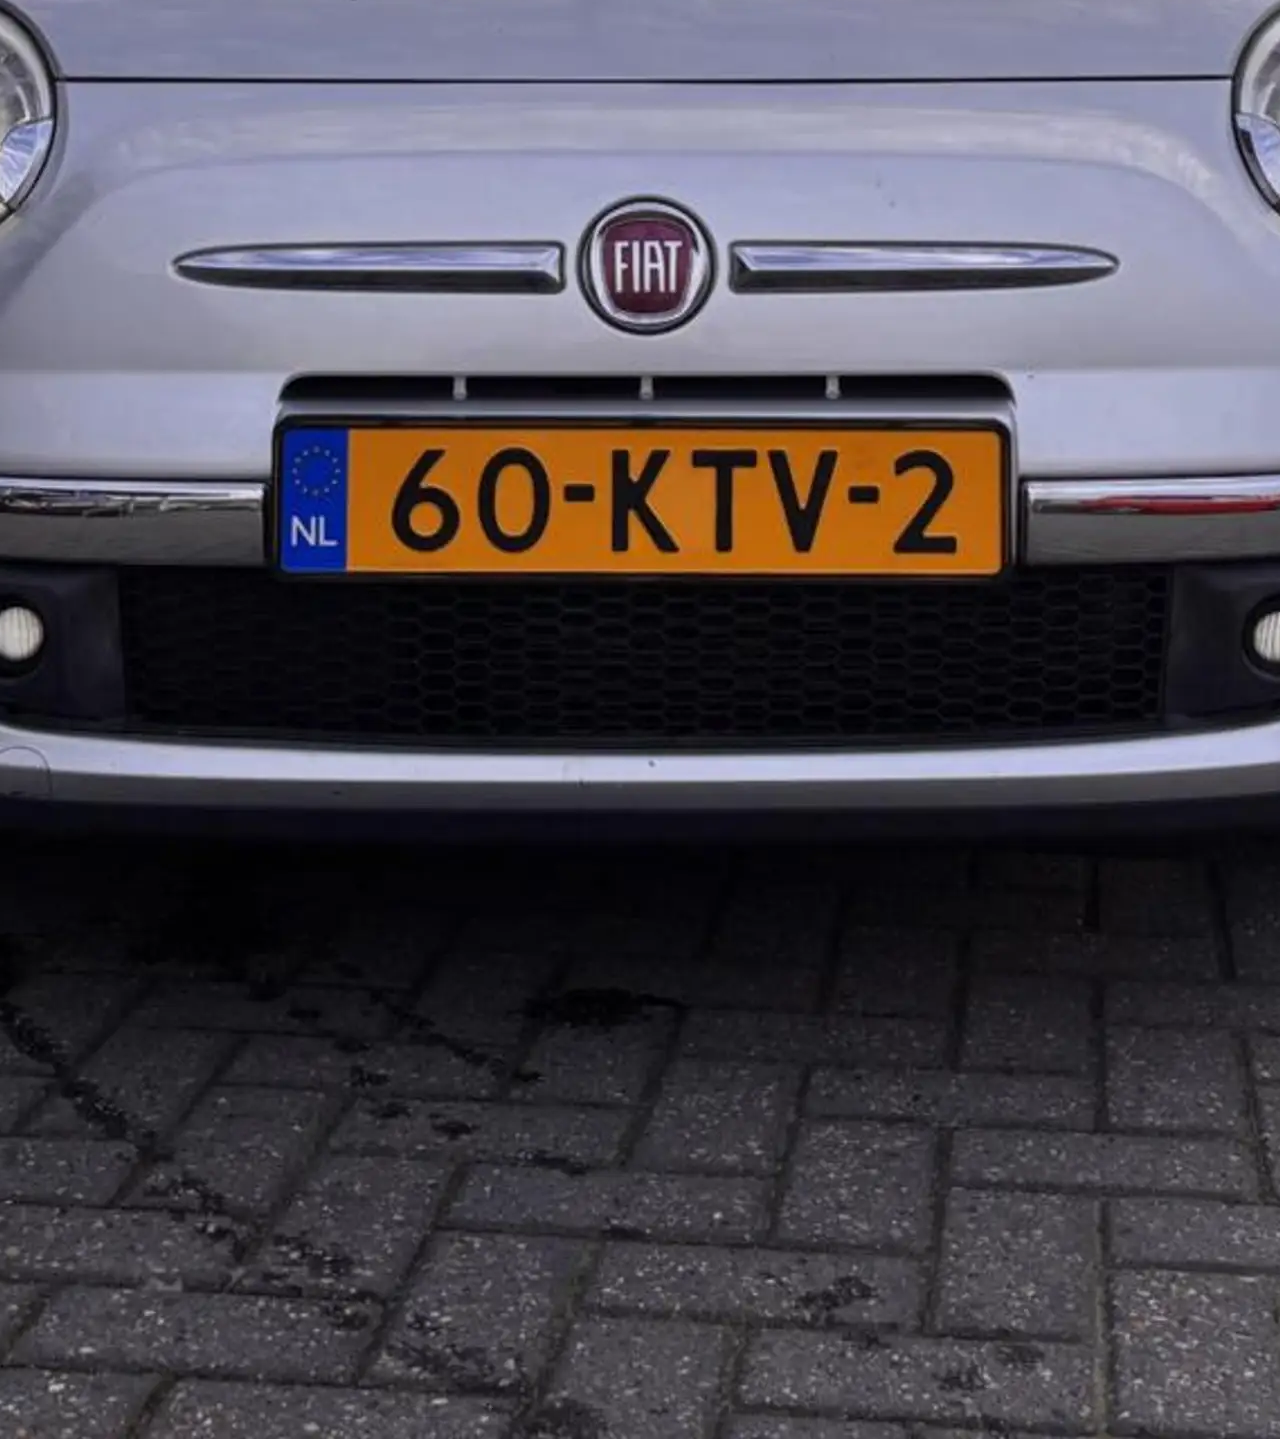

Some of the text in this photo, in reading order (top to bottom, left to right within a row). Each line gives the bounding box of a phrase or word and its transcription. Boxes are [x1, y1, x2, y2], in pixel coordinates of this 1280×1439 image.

[614, 240, 683, 293] FIAT
[391, 448, 958, 554] 60-KTV-2
[291, 515, 338, 547] NL
